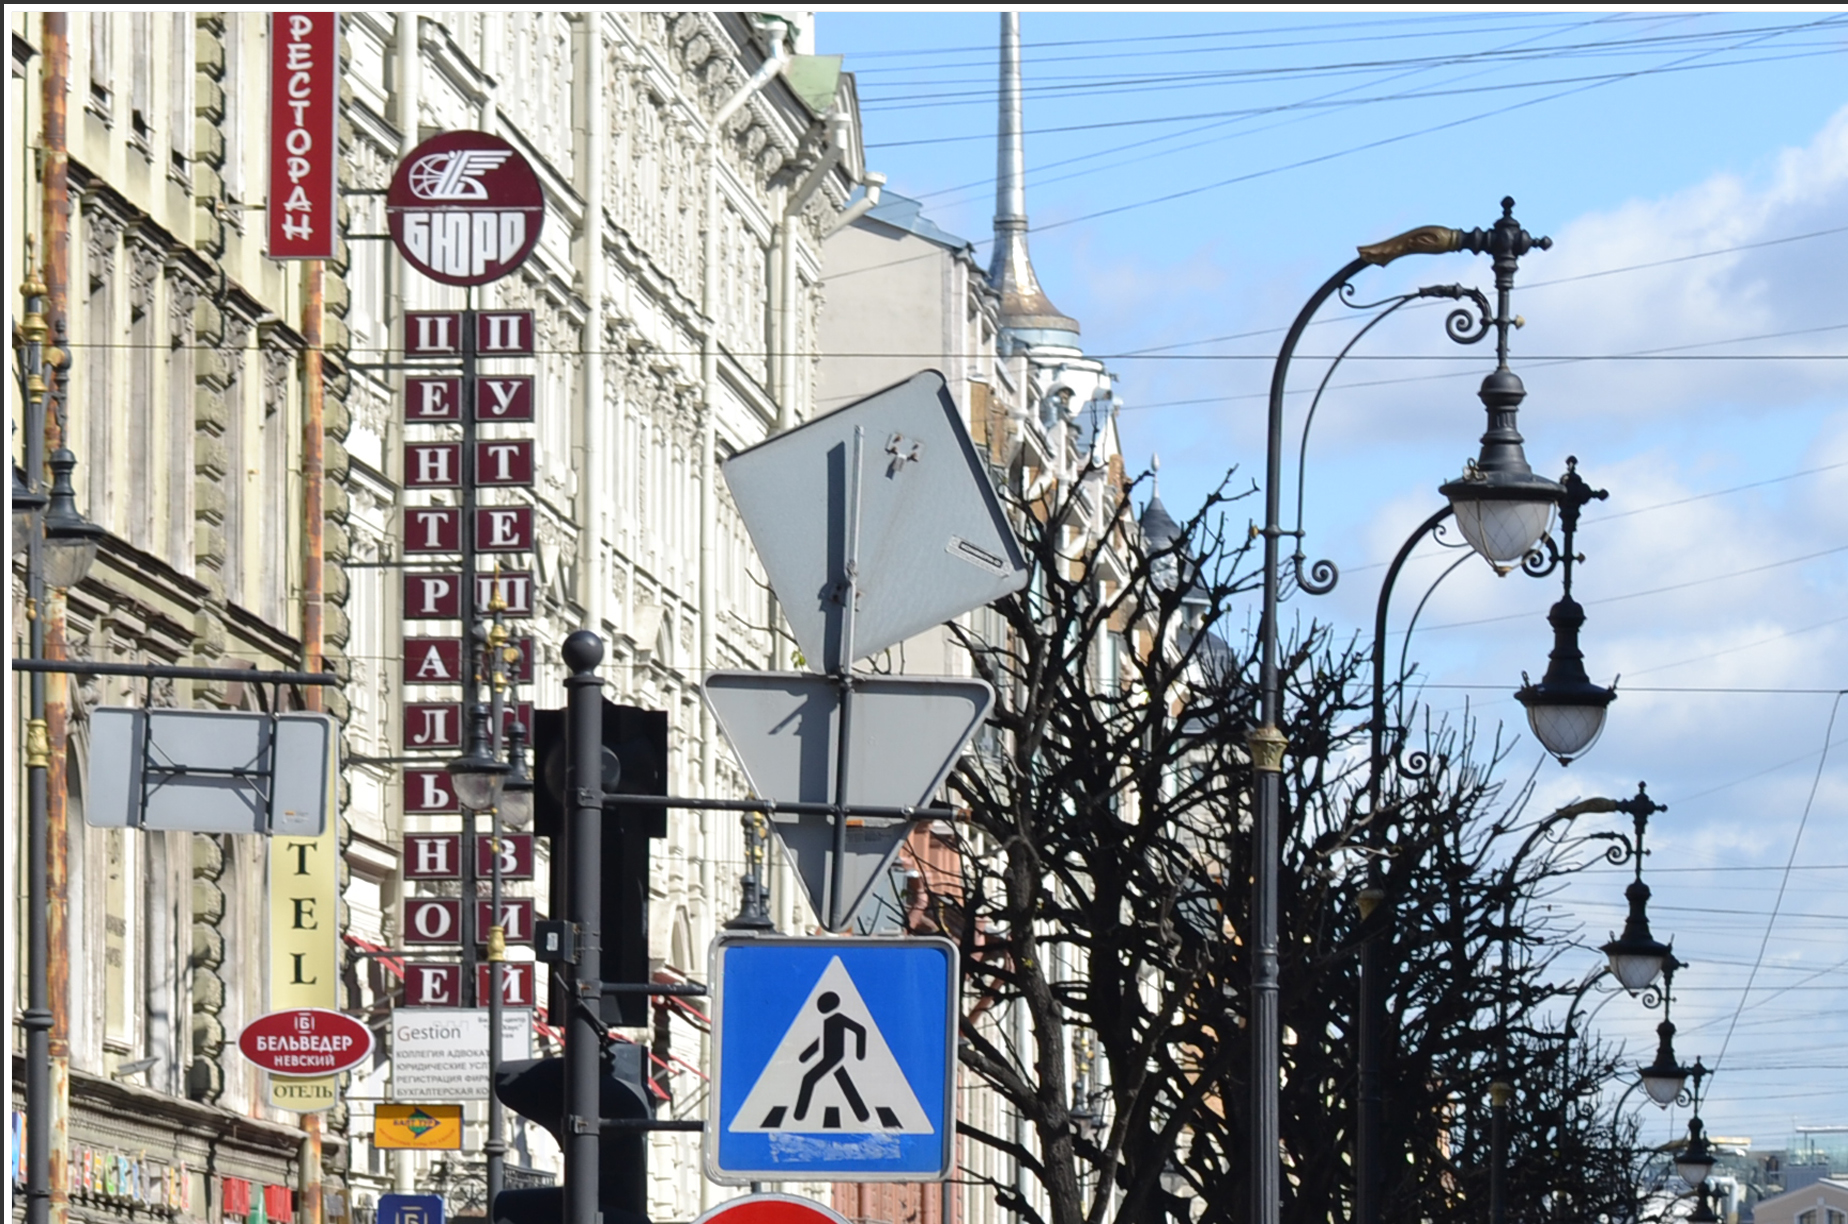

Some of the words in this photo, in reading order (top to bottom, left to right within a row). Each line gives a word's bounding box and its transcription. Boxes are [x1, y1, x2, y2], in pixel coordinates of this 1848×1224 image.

[281, 14, 314, 241] РЕСТОРАН
[403, 212, 526, 277] БЮРО
[413, 316, 454, 1004] ЦЕНТРАЛЬНОЕ
[286, 841, 318, 986] TEL
[396, 1025, 462, 1042] Gestion
[256, 1035, 353, 1053] БЕЛЬВЕДЕР
[273, 1054, 336, 1067] НЕВСКИЙ
[396, 1050, 445, 1059] КОЛЛЕГИЯ
[447, 1050, 490, 1059] АДВОКАТ
[396, 1062, 467, 1071] ЮРИДИЧЕСКИЕ
[396, 1075, 463, 1084] РЕГИСТРАЦИЯ
[273, 1084, 334, 1099] ОТЕЛЬ
[396, 1088, 473, 1097] БУХГАЛТЕРСКАЯ
